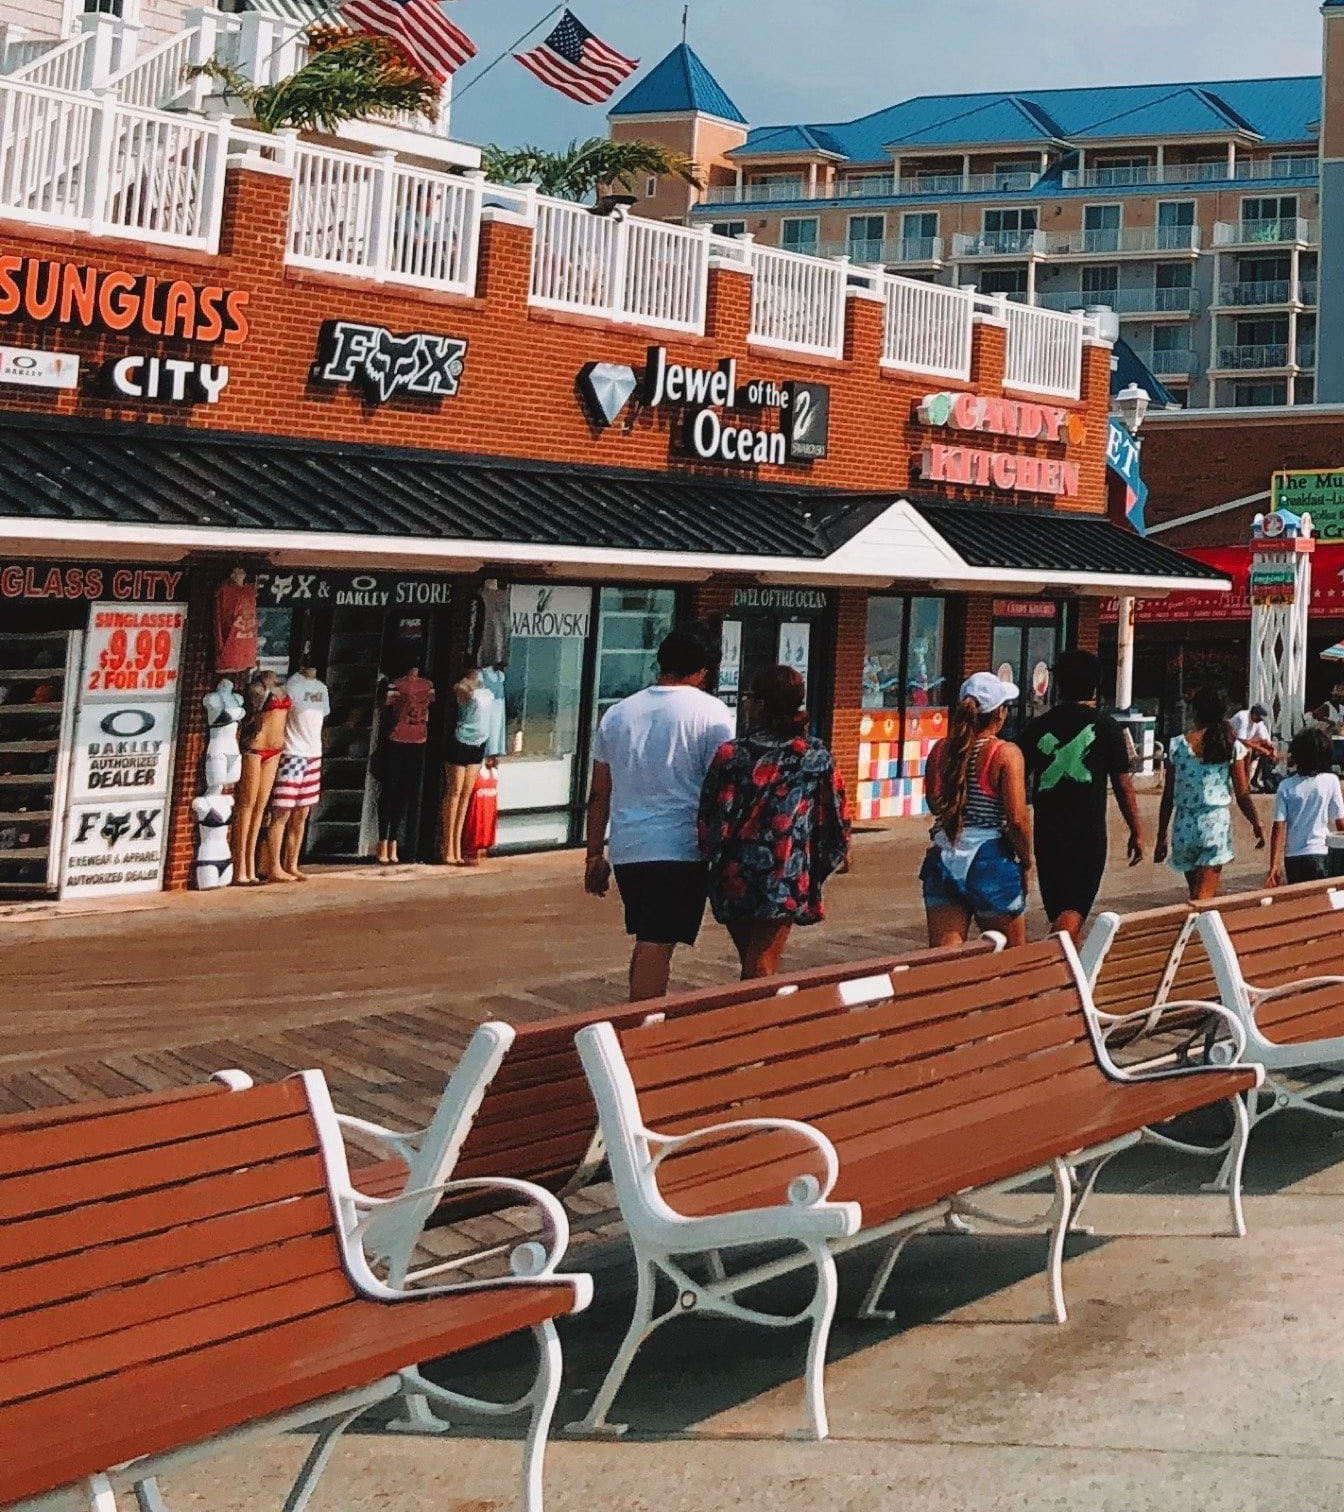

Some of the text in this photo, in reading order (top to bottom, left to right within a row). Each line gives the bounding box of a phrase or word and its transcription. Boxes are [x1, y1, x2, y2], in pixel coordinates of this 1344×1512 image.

[0, 255, 249, 344] SUNGLASS
[114, 355, 229, 404] CITY
[651, 347, 789, 409] Jewel of the
[955, 392, 1067, 441] CANDY
[693, 409, 786, 465] Ocean
[930, 443, 1080, 496] KITCHEN
[1275, 474, 1308, 490] The
[113, 569, 183, 600] CITY
[318, 581, 329, 598] &
[336, 590, 389, 606] OAKLEY
[396, 582, 452, 603] STORE
[95, 612, 181, 628] SUNGLASSES
[510, 612, 590, 637] WAROVSKI
[100, 629, 171, 670] $9.99
[88, 671, 101, 691] 2
[104, 671, 138, 690] FOR
[88, 740, 163, 755] OAKLEY
[90, 756, 158, 770] AUTHORIZED
[87, 769, 157, 789] DEALER
[68, 855, 111, 868] EYEWEAR
[123, 851, 160, 864] APPAREL
[67, 869, 159, 886] AUTHORIZED DEALER
